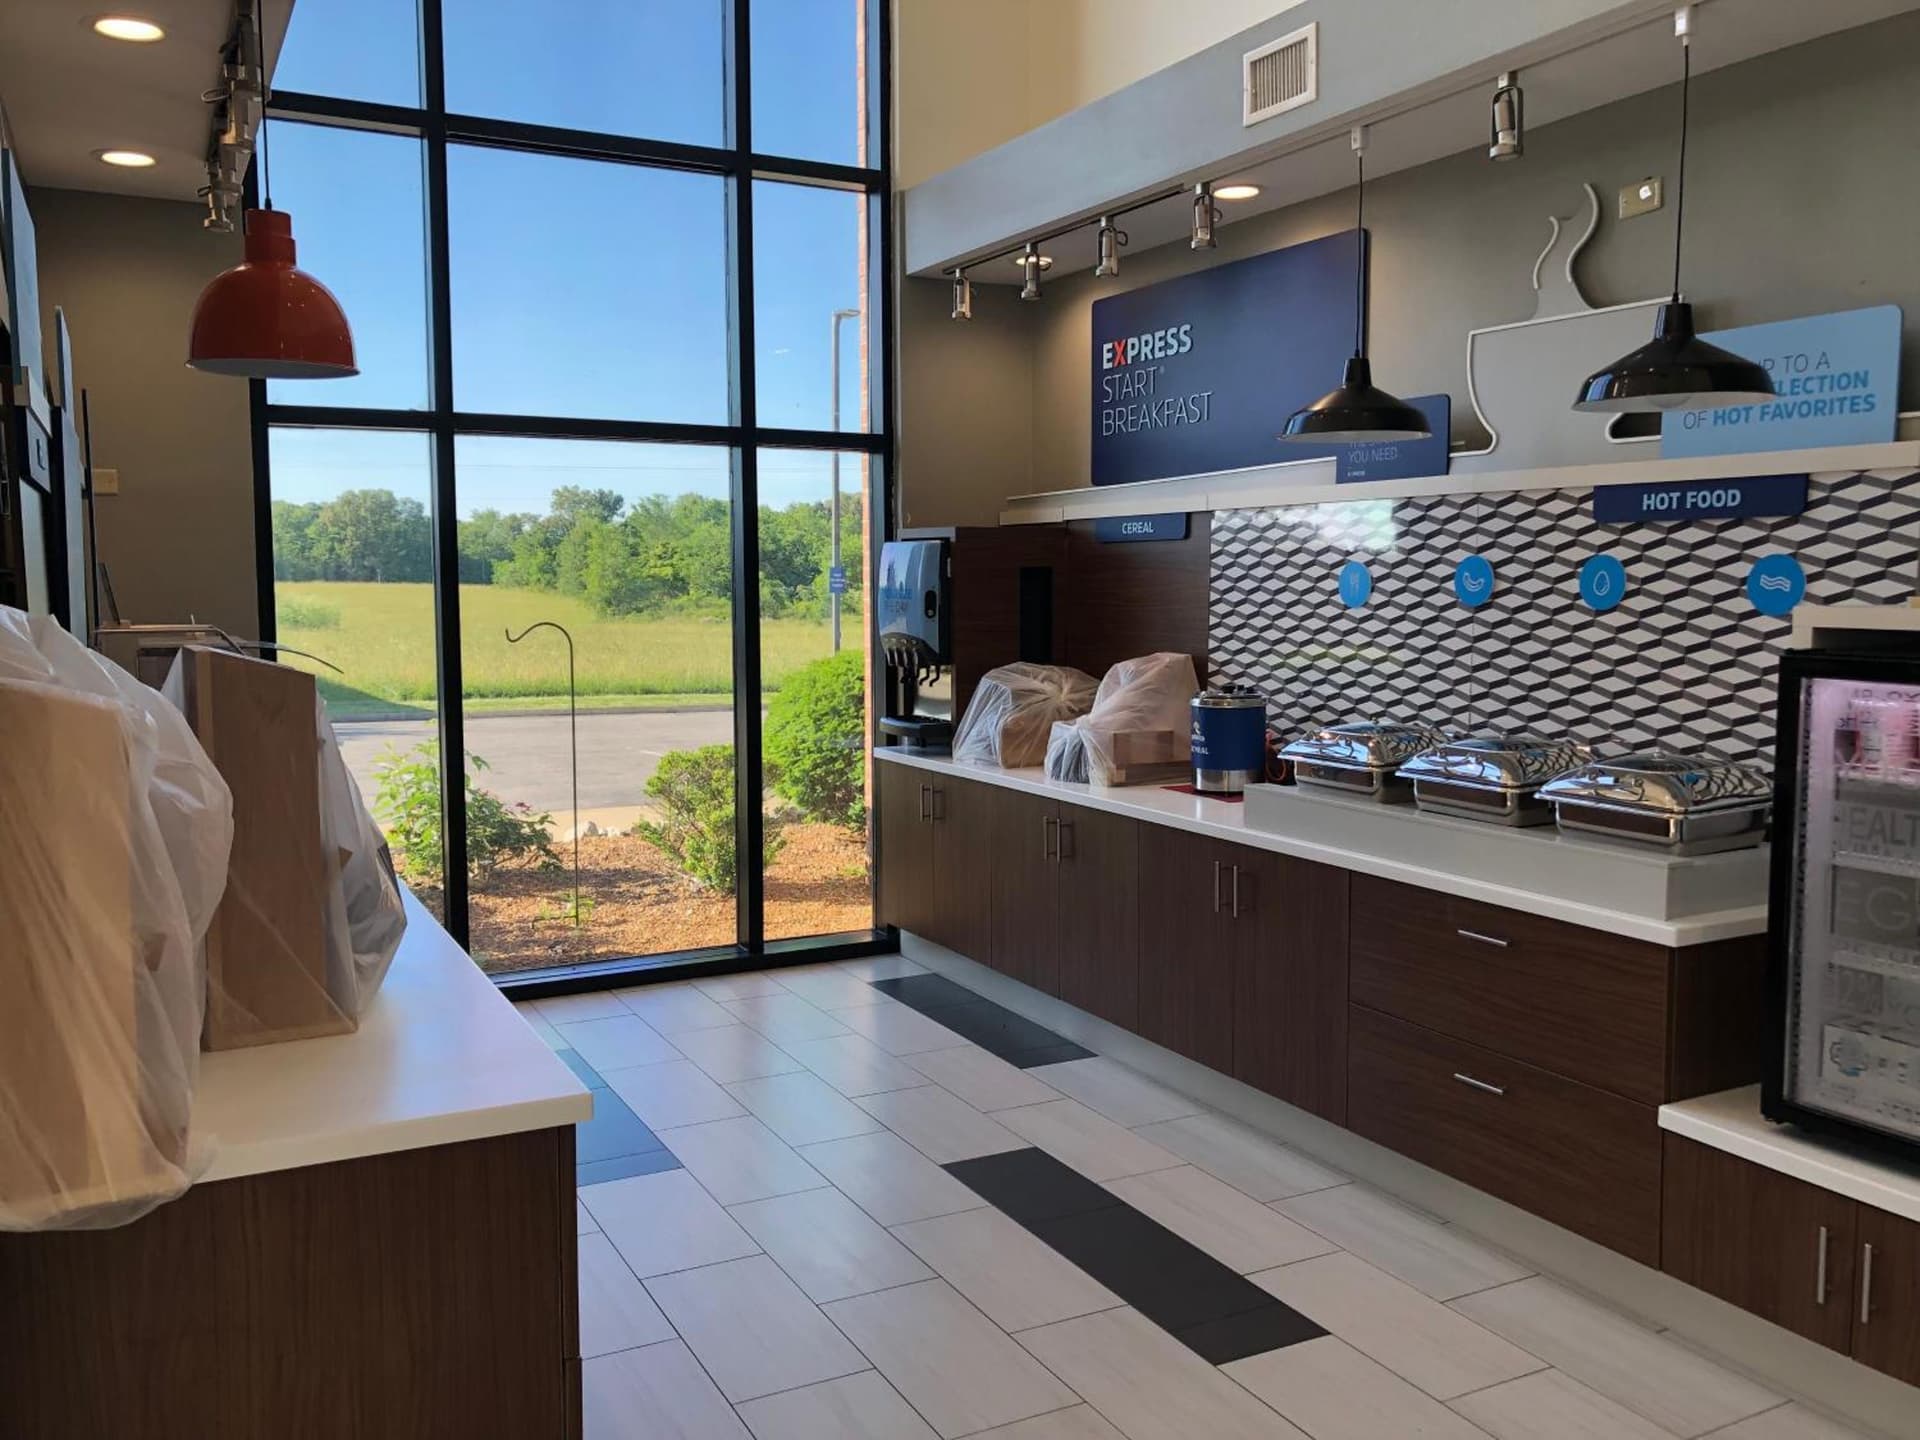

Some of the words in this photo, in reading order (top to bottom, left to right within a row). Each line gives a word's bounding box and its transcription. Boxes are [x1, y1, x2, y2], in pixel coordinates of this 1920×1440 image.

[1103, 323, 1192, 369] EXPRESS
[1784, 353, 1809, 374] TO
[1816, 351, 1831, 370] A
[1774, 370, 1870, 397] LECTION
[1103, 391, 1212, 436] BREAKFAST
[1683, 410, 1707, 430] OF
[1713, 406, 1753, 427] HOT
[1759, 393, 1876, 422] FAVORITES
[1347, 450, 1369, 463] YOU
[1642, 491, 1681, 511] HOT
[1686, 489, 1742, 509] FOOD
[1121, 521, 1154, 534] CEREAL
